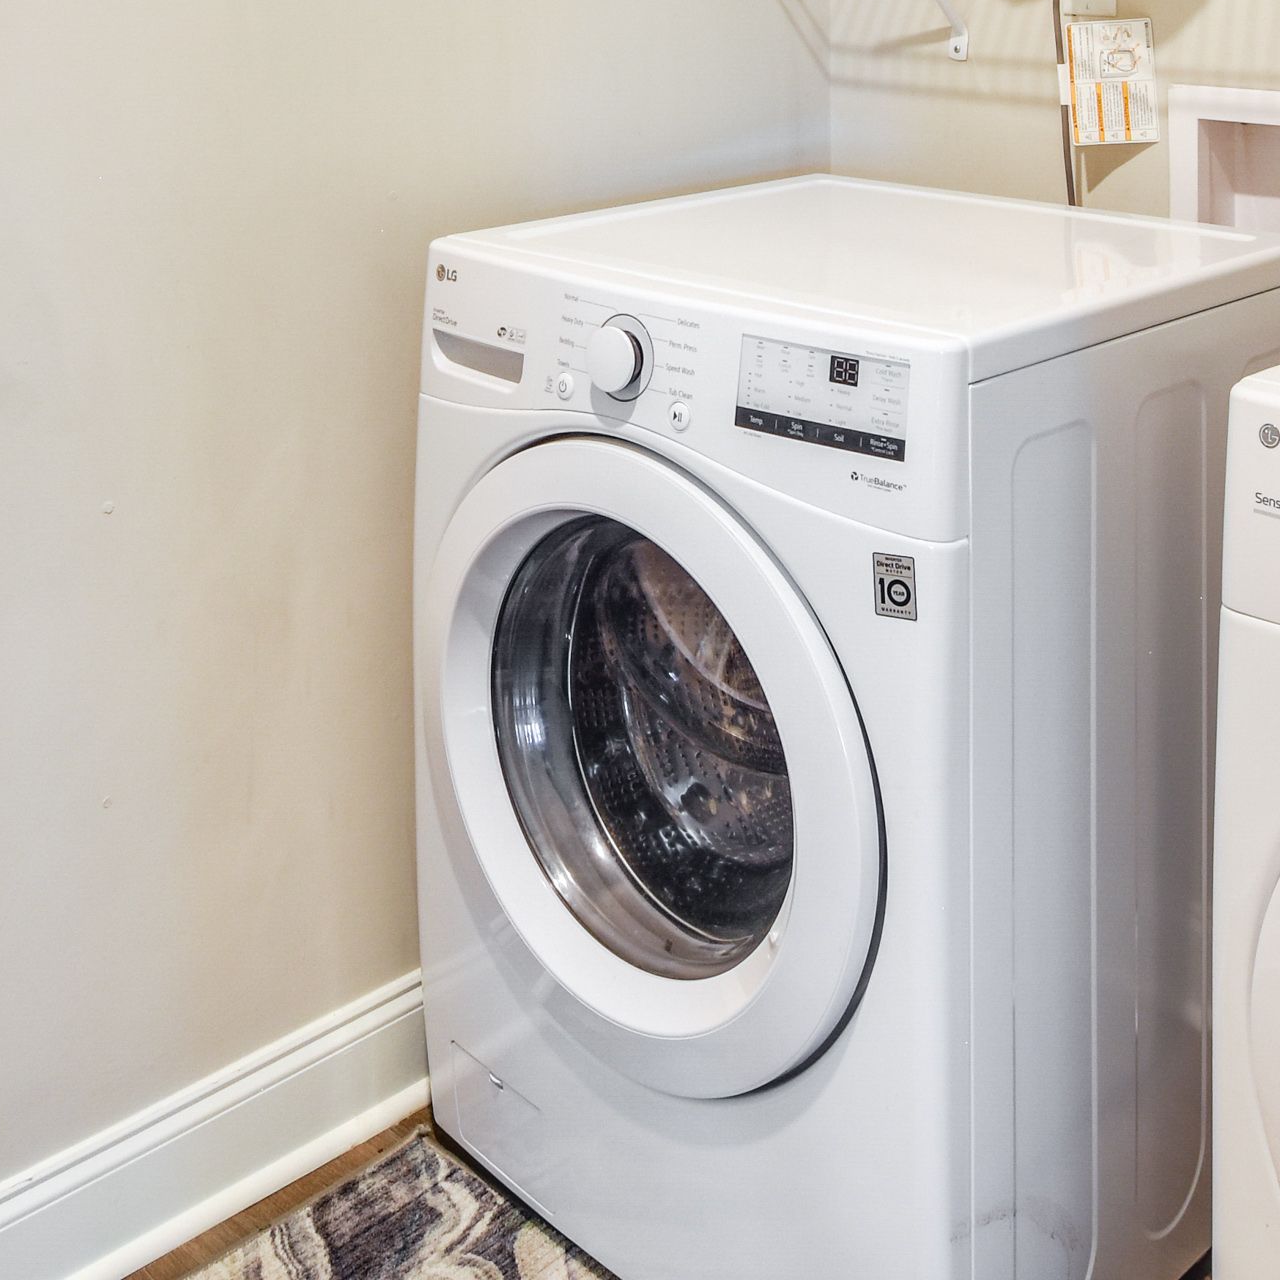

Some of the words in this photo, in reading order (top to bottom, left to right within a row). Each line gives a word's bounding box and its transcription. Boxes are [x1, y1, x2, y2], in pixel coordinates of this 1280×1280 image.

[791, 421, 803, 431] Spin
[833, 433, 845, 442] Soil
[876, 560, 894, 570] Direct
[894, 561, 911, 571] Drive
[878, 577, 911, 607] 10
[892, 589, 905, 597] YEAR
